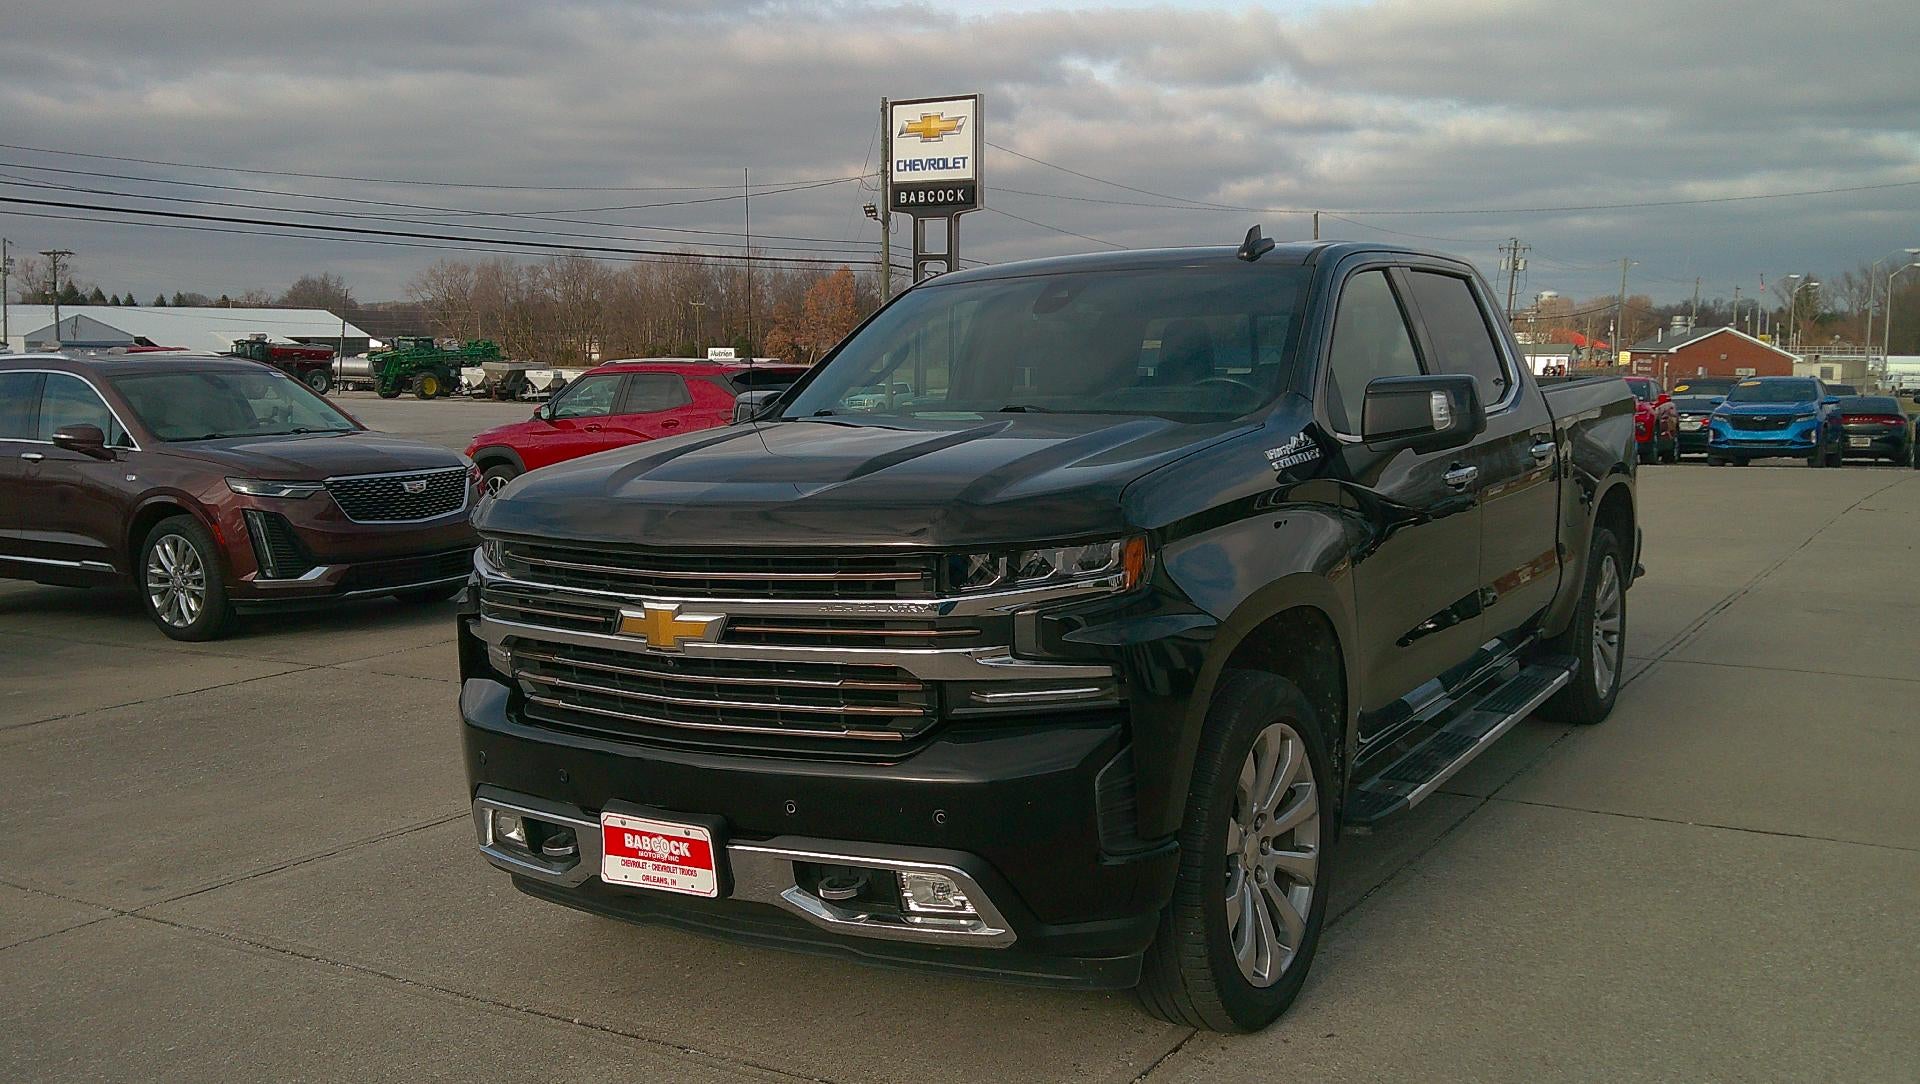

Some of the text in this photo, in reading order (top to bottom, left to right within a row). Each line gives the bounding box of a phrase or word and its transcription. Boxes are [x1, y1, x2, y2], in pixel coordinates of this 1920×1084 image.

[896, 156, 968, 172] CHEVROLET
[900, 189, 965, 204] BABCOCK
[624, 833, 691, 857] BABCOCK
[620, 858, 648, 870] CHEVROLET
[651, 863, 678, 875] CHEVROLET
[678, 867, 698, 878] TRUCKS
[641, 874, 677, 886] ORLEANS, IN
